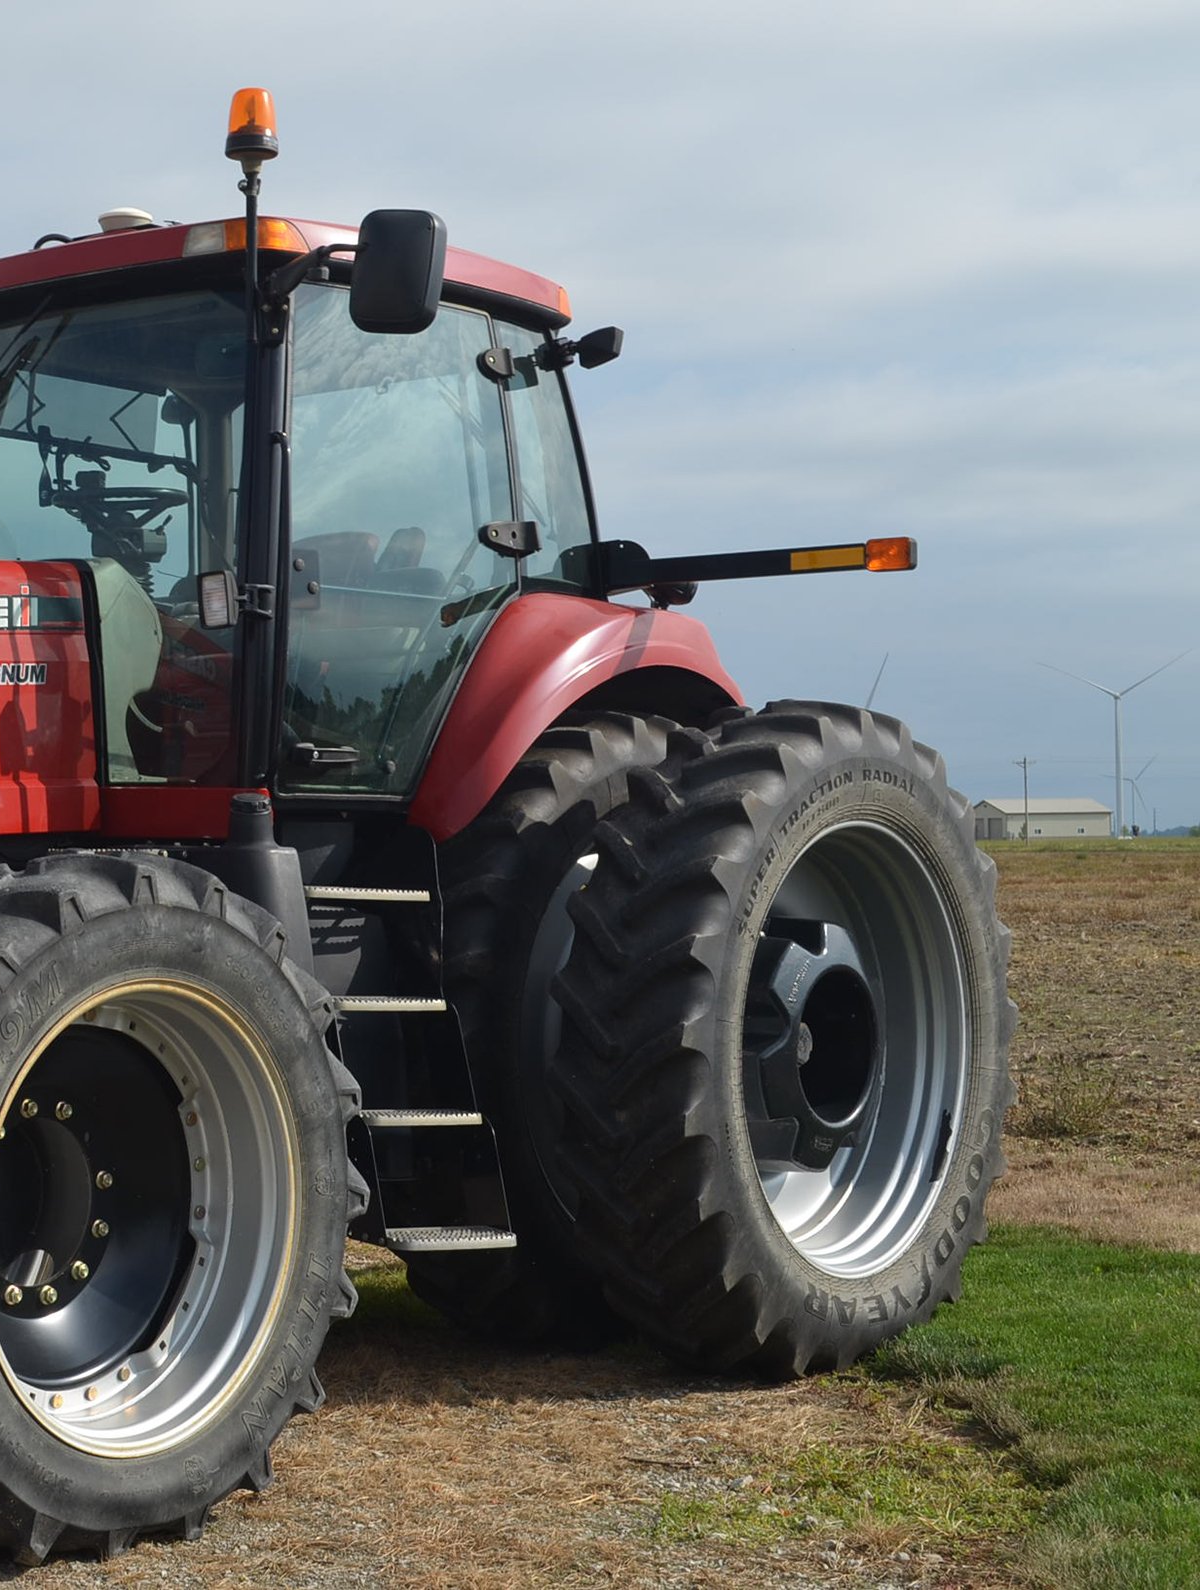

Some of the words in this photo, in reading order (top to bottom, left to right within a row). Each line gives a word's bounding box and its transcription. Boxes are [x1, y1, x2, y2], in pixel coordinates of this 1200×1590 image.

[737, 847, 777, 935] SUPER
[779, 771, 854, 837] TRACTION
[863, 769, 917, 798] RADIAL
[241, 1251, 335, 1442] TITAN
